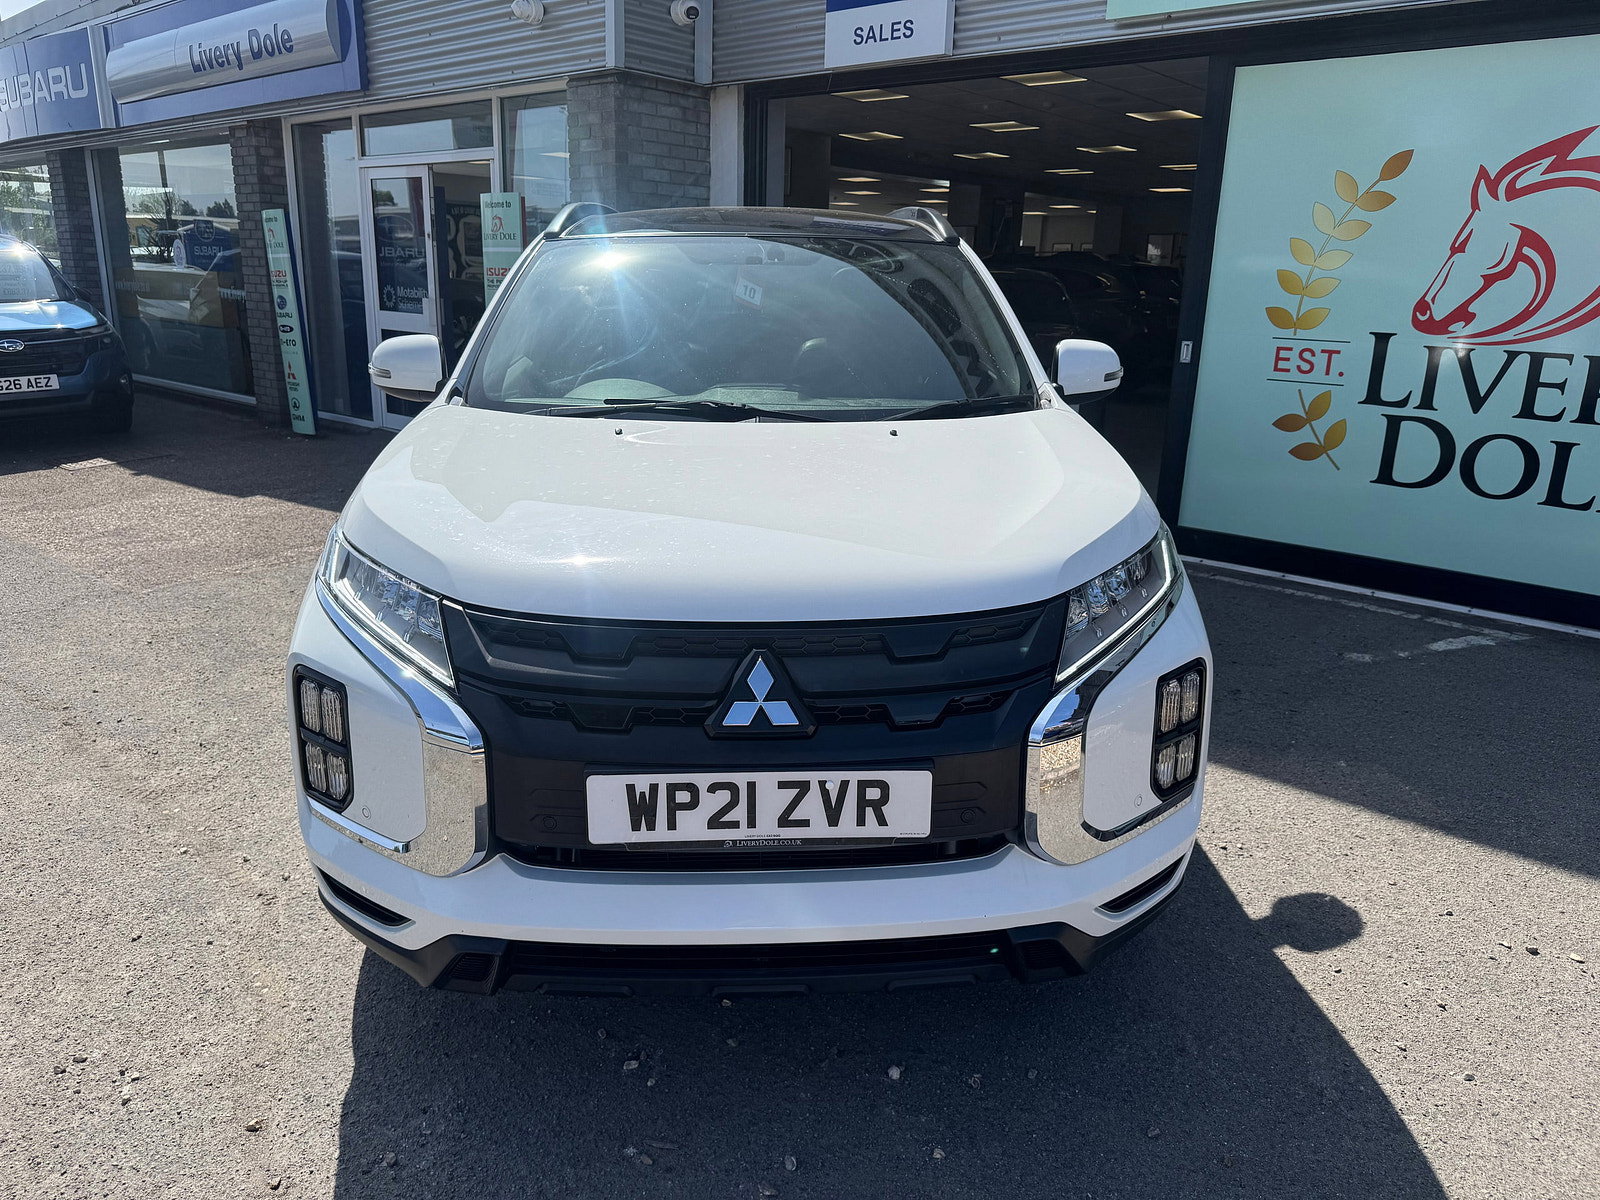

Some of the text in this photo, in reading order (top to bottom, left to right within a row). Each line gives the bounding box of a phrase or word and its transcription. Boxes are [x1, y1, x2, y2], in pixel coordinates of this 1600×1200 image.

[853, 19, 914, 46] SALES
[189, 23, 294, 73] Livery Dole
[505, 200, 512, 208] to
[500, 232, 517, 240] DOLE
[193, 245, 223, 256] SUBARU
[486, 267, 511, 277] ISUZ
[397, 286, 429, 299] Motability
[742, 284, 757, 299] 10
[1272, 345, 1345, 378] EST.
[27, 377, 53, 389] AEZ
[1369, 412, 1600, 512] DOL
[625, 778, 891, 832] WP21 ZVR
